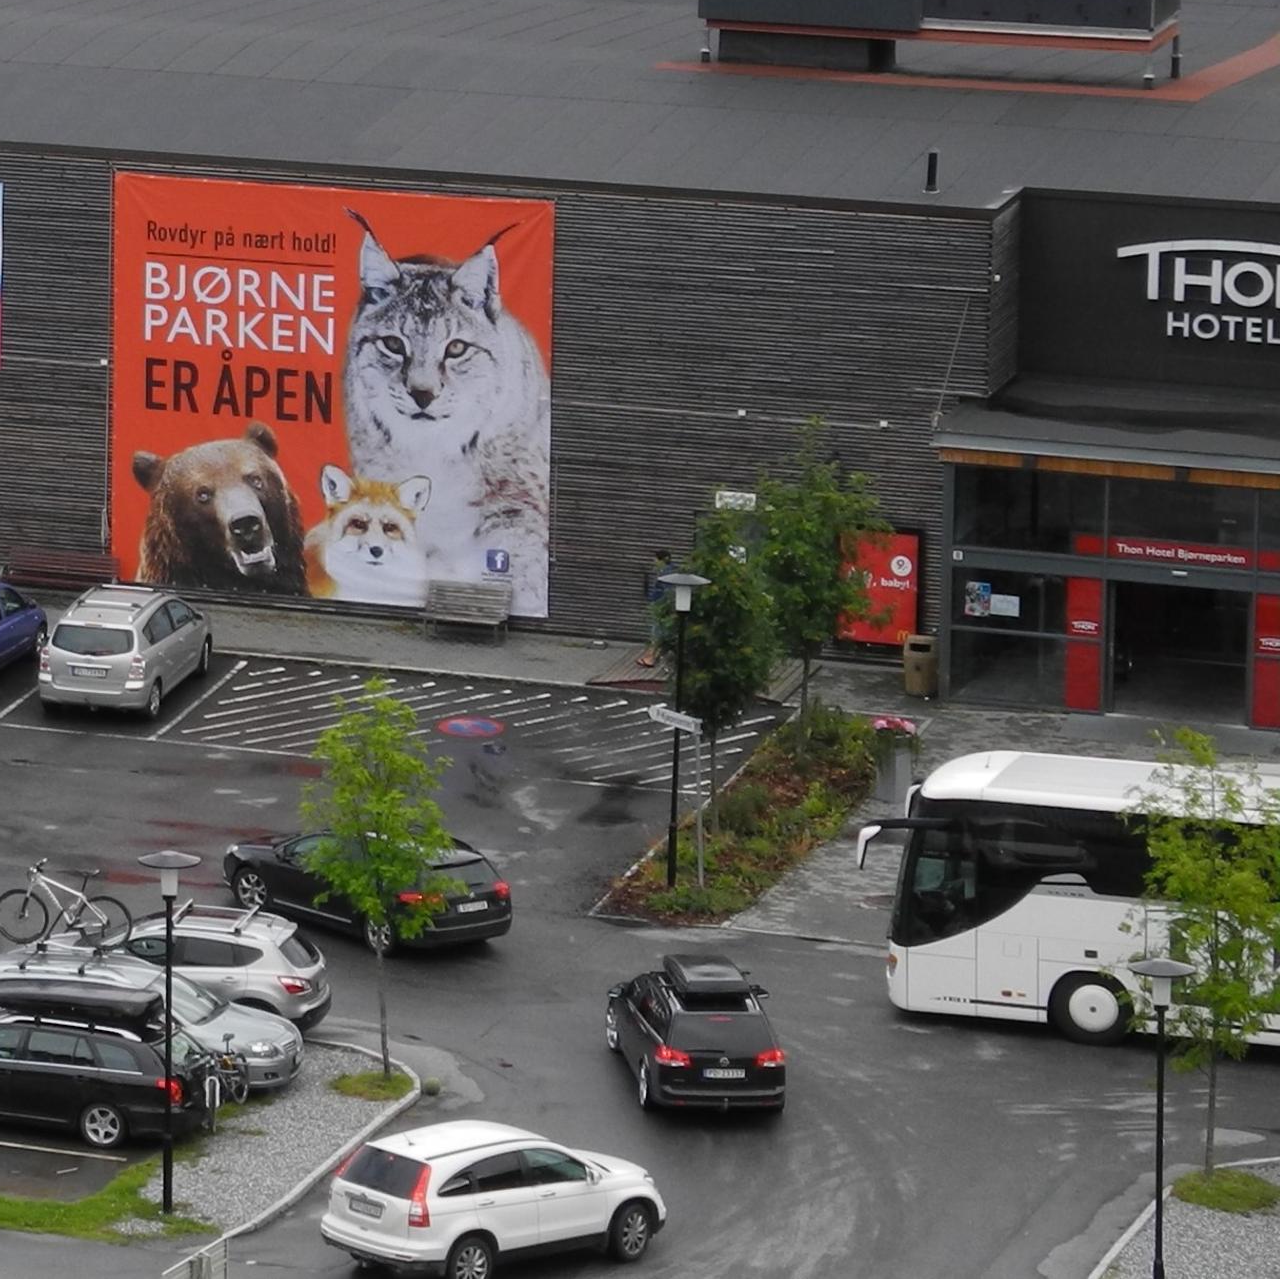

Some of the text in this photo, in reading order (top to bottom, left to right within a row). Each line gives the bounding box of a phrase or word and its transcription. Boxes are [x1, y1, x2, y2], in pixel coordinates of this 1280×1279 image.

[147, 220, 336, 254] Rovdyr på nært hold!
[145, 262, 335, 313] BJØRNE
[1117, 239, 1280, 309] THO
[144, 304, 334, 355] PARKEN
[146, 350, 332, 424] ER ÅPEN
[1117, 543, 1246, 565] Thon Hotel Bjørneparken
[881, 577, 910, 591] baby!
[1072, 621, 1098, 630] THON
